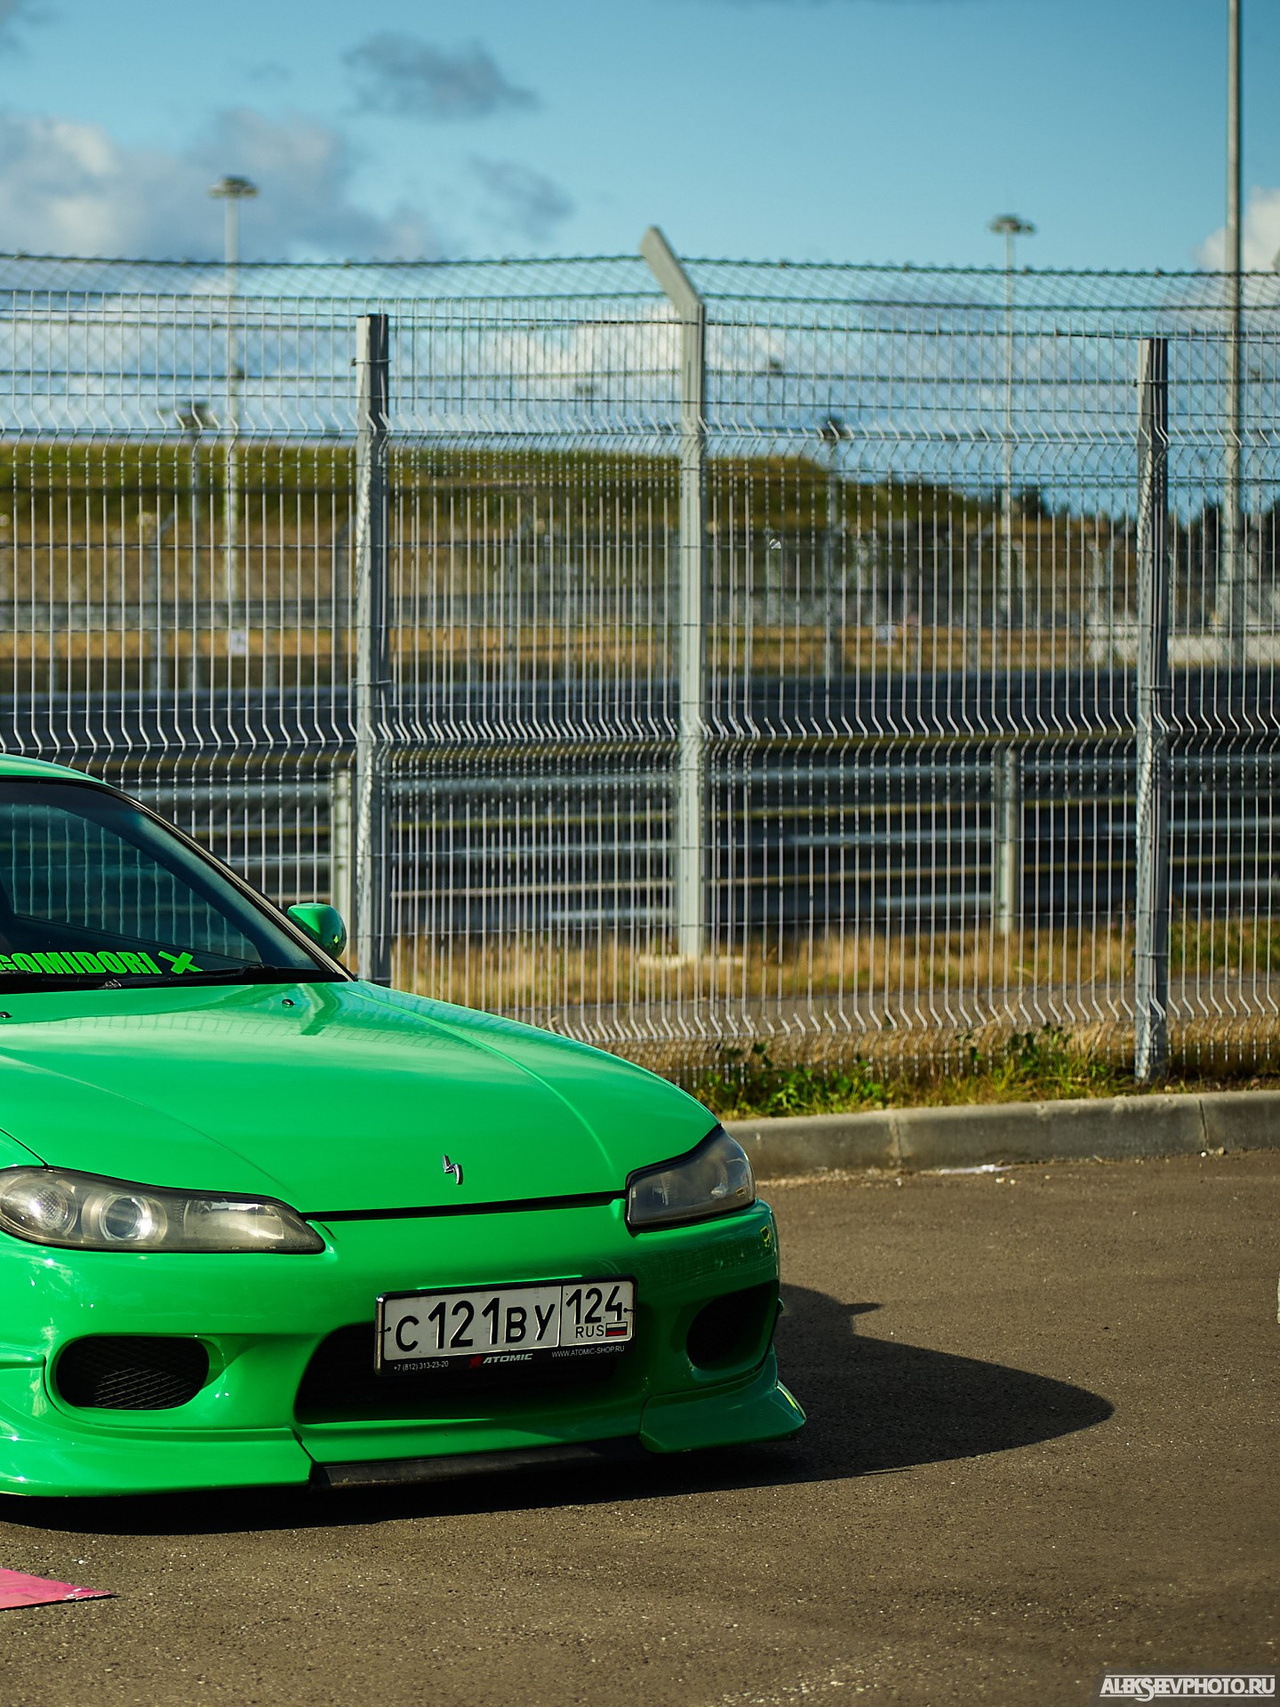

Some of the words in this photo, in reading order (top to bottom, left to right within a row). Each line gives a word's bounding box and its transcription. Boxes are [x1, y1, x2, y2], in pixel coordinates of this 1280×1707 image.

[565, 1285, 623, 1326] 124
[575, 1324, 605, 1339] RUS
[551, 1345, 625, 1358] WWW.ATOMIC-SHOP.RU
[482, 1353, 534, 1365] ATOMIC
[402, 1362, 419, 1372] (812)
[419, 1360, 449, 1370] 313-23-20
